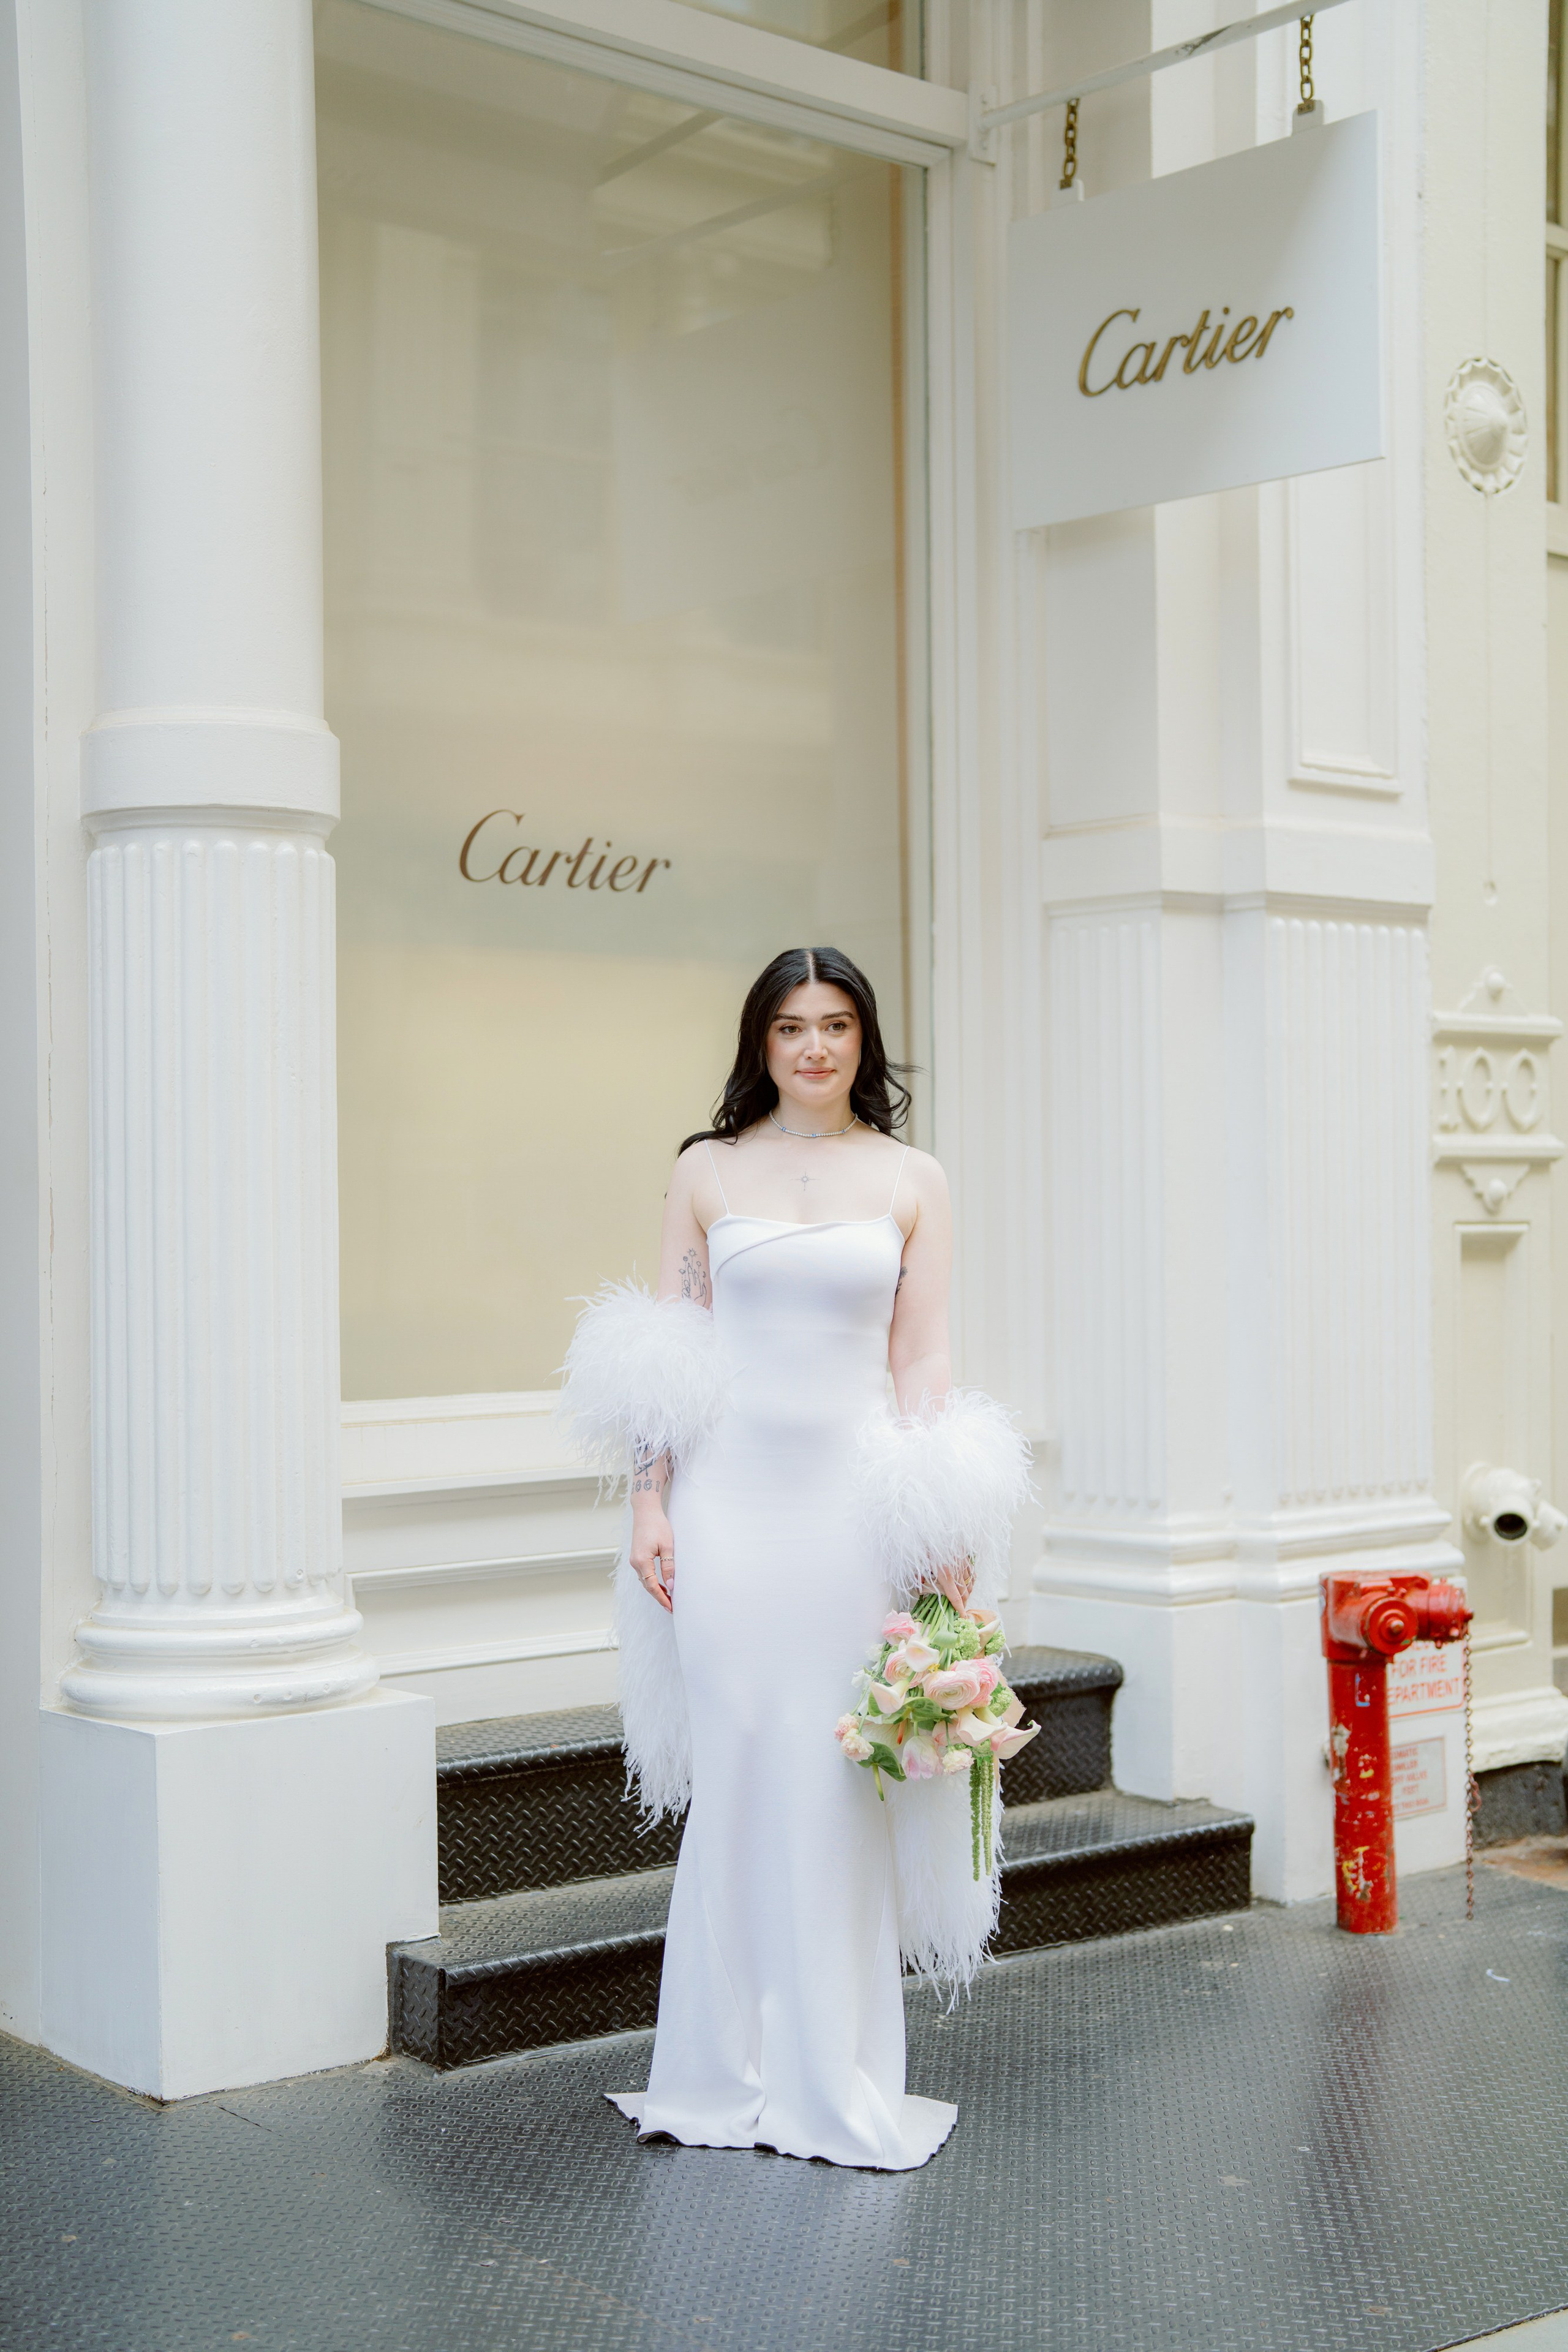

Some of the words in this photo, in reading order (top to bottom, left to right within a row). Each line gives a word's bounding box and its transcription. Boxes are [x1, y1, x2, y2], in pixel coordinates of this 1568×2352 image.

[1078, 306, 1294, 397] Cartier
[459, 810, 671, 893] Cartier
[1437, 1045, 1543, 1132] 100
[1386, 1678, 1460, 1706] EPARTMENT
[1392, 1659, 1416, 1679] FOR
[1420, 1654, 1447, 1676] FIRE
